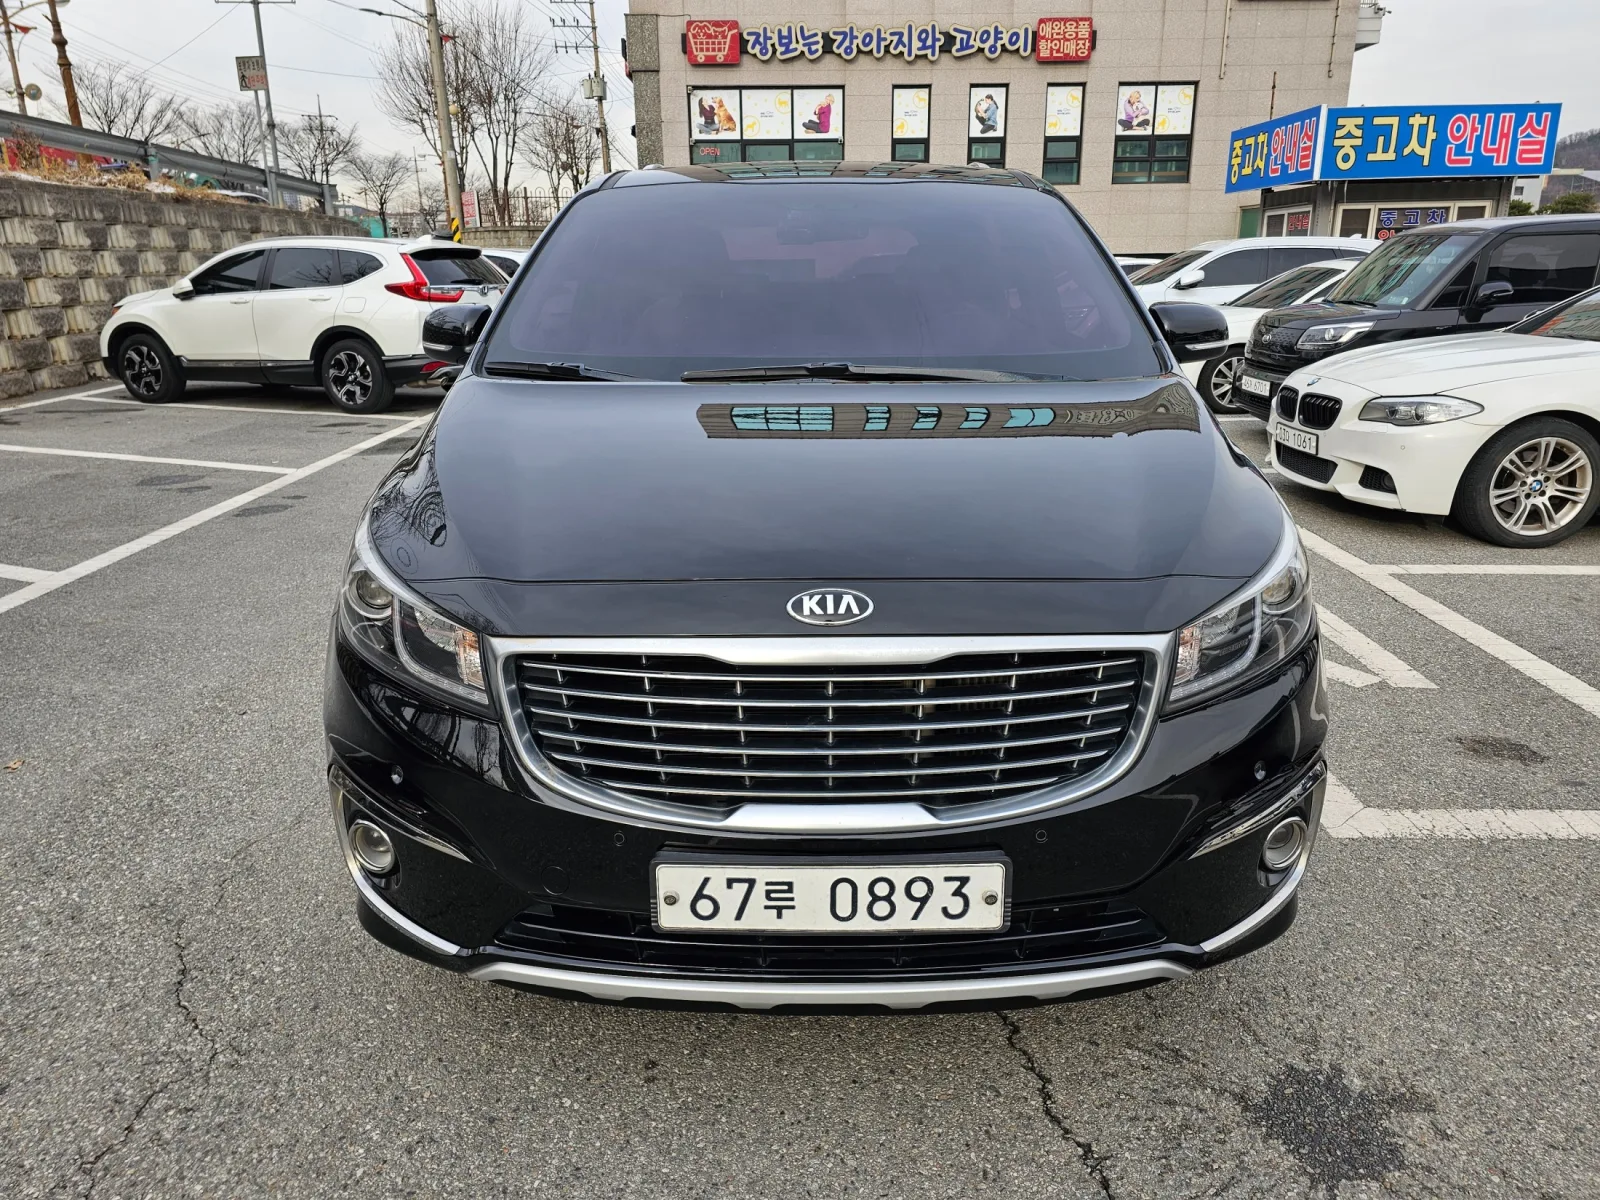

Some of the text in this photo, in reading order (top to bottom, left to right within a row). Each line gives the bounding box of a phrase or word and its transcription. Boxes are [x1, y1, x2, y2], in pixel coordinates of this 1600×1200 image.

[744, 22, 1031, 59] 장보는 강아지와 고양이
[1039, 21, 1091, 39] 애완용품
[1038, 39, 1090, 57] 할인매장
[700, 147, 721, 156] OPEN
[1230, 117, 1317, 185] 중고차 안내실
[1333, 111, 1552, 171] 중고차 안내실
[1293, 433, 1312, 450] 1061
[801, 594, 861, 616] KIA
[689, 875, 972, 922] 67루 0893
